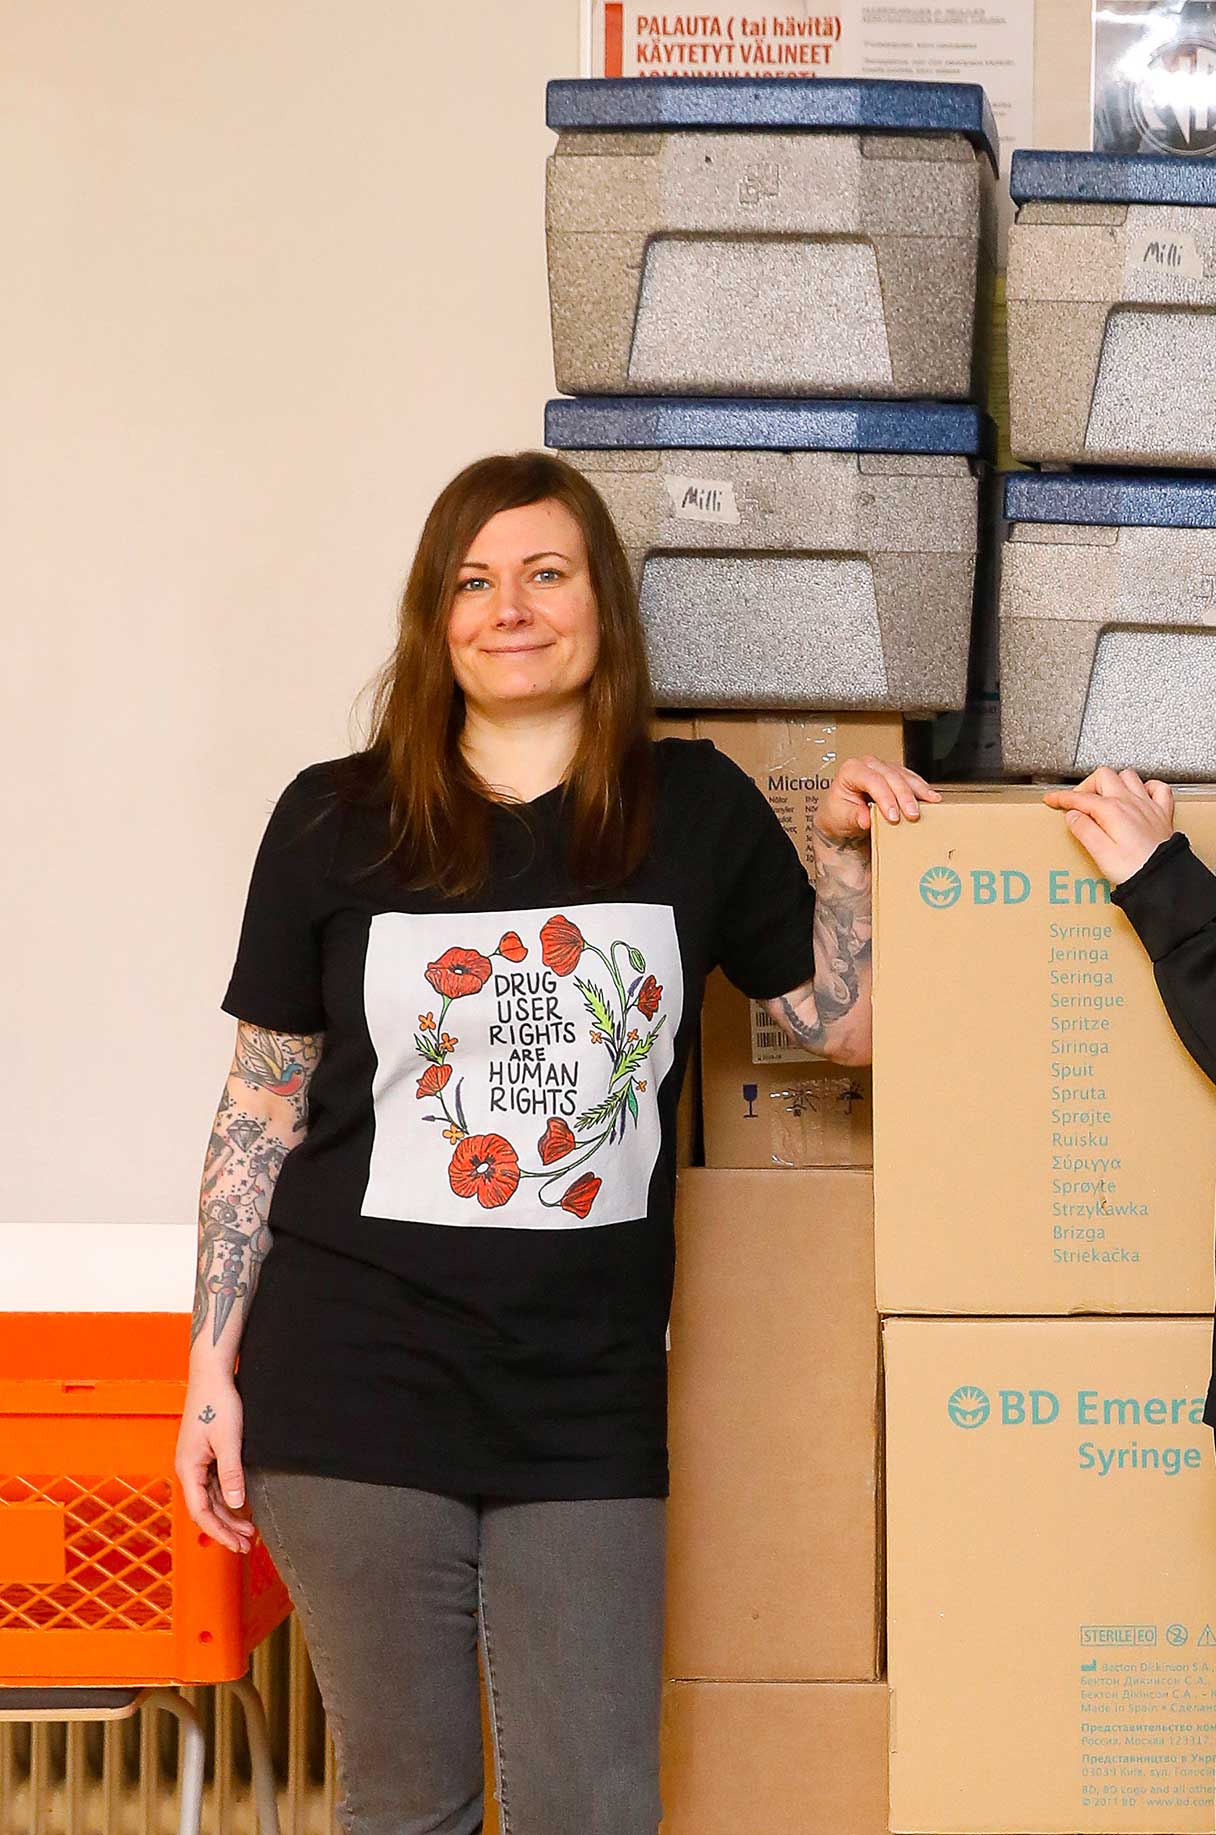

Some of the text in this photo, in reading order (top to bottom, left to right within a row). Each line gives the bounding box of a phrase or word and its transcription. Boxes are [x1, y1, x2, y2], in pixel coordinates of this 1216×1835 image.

[637, 16, 721, 37] PALAUTA
[741, 17, 767, 37] tai
[772, 16, 842, 41] hävitä)
[637, 39, 832, 65] KÄYTETYT VÄLINEET
[1143, 241, 1182, 267] Milli
[682, 486, 723, 513] Milli
[768, 774, 833, 791] Microla
[970, 869, 1032, 906] BD
[1049, 923, 1113, 941] Syringe
[1048, 947, 1109, 964] Jeringa
[495, 971, 557, 998] DRUG
[1050, 970, 1113, 987] Seringa
[1050, 993, 1125, 1009] Seringue
[497, 997, 563, 1023] USER
[1051, 1017, 1110, 1033] Spritze
[489, 1022, 576, 1047] RIGHTS
[509, 1047, 546, 1062] ARE
[1051, 1040, 1109, 1057] Siringa
[489, 1061, 578, 1088] HUMAN
[1051, 1063, 1094, 1079] Spuit
[490, 1088, 577, 1116] RIGHTS
[1051, 1086, 1107, 1103] Spruta
[1051, 1110, 1112, 1126] Sprøjte
[1052, 1133, 1109, 1148] Ruisku
[1052, 1155, 1122, 1172] Σύριγγα
[1052, 1179, 1117, 1196] Sprøyte
[1053, 1202, 1148, 1219] Strzykawka
[1053, 1225, 1106, 1242] Brizga
[1053, 1247, 1140, 1264] Striekačka
[998, 1390, 1206, 1425] BD Emera
[1078, 1441, 1202, 1476] Syringe
[1083, 1629, 1155, 1643] STERILE EO
[1081, 1703, 1110, 1712] Made
[1128, 1703, 1157, 1714] Spain
